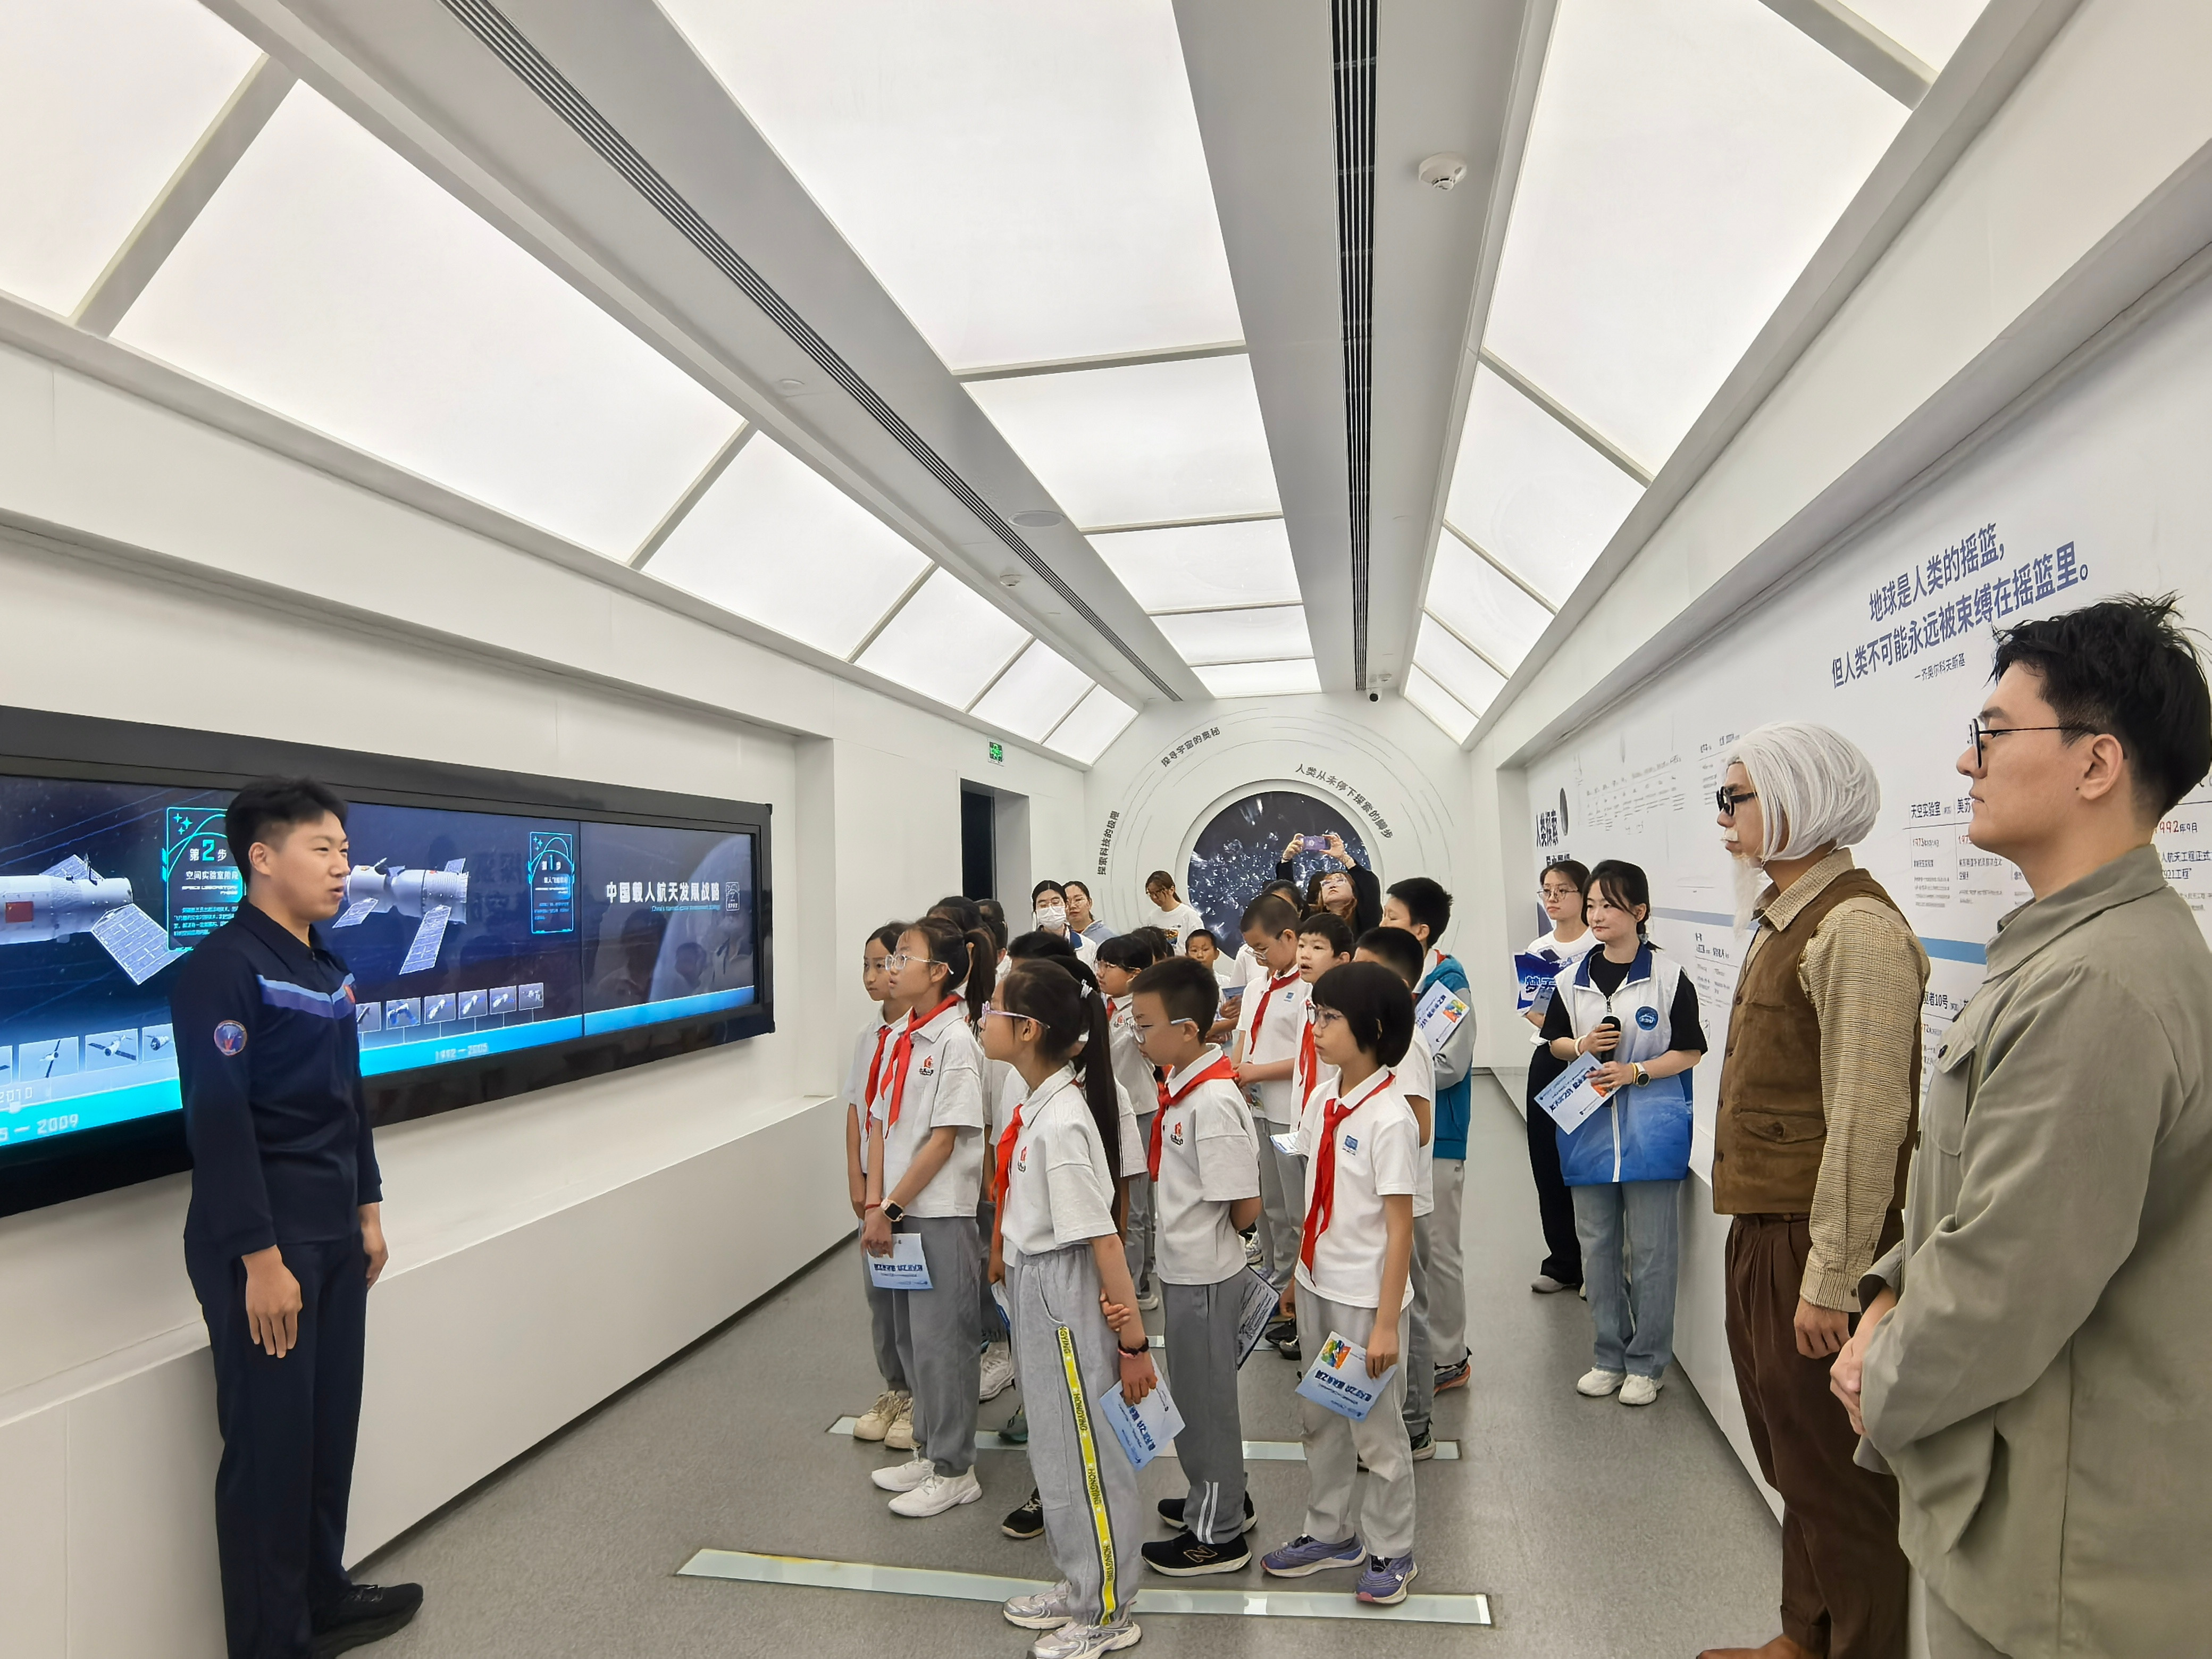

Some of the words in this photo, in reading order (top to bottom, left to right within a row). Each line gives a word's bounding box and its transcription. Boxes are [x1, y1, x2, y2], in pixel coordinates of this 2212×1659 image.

[1832, 541, 2088, 689] 但人类不可能永远被束缚在摇篮里。
[1161, 726, 1221, 767] 探寻宇宙的奥秘
[1295, 763, 1394, 839] 人类从未停下探索的脚步
[1911, 801, 1941, 818] 天空实验室
[2155, 821, 2198, 833] 992年9月
[189, 839, 227, 861] 第2步
[606, 881, 720, 903] 中国载人航天发展战略
[36, 1113, 79, 1135] 2009
[1087, 1468, 1102, 1505] HONGYING
